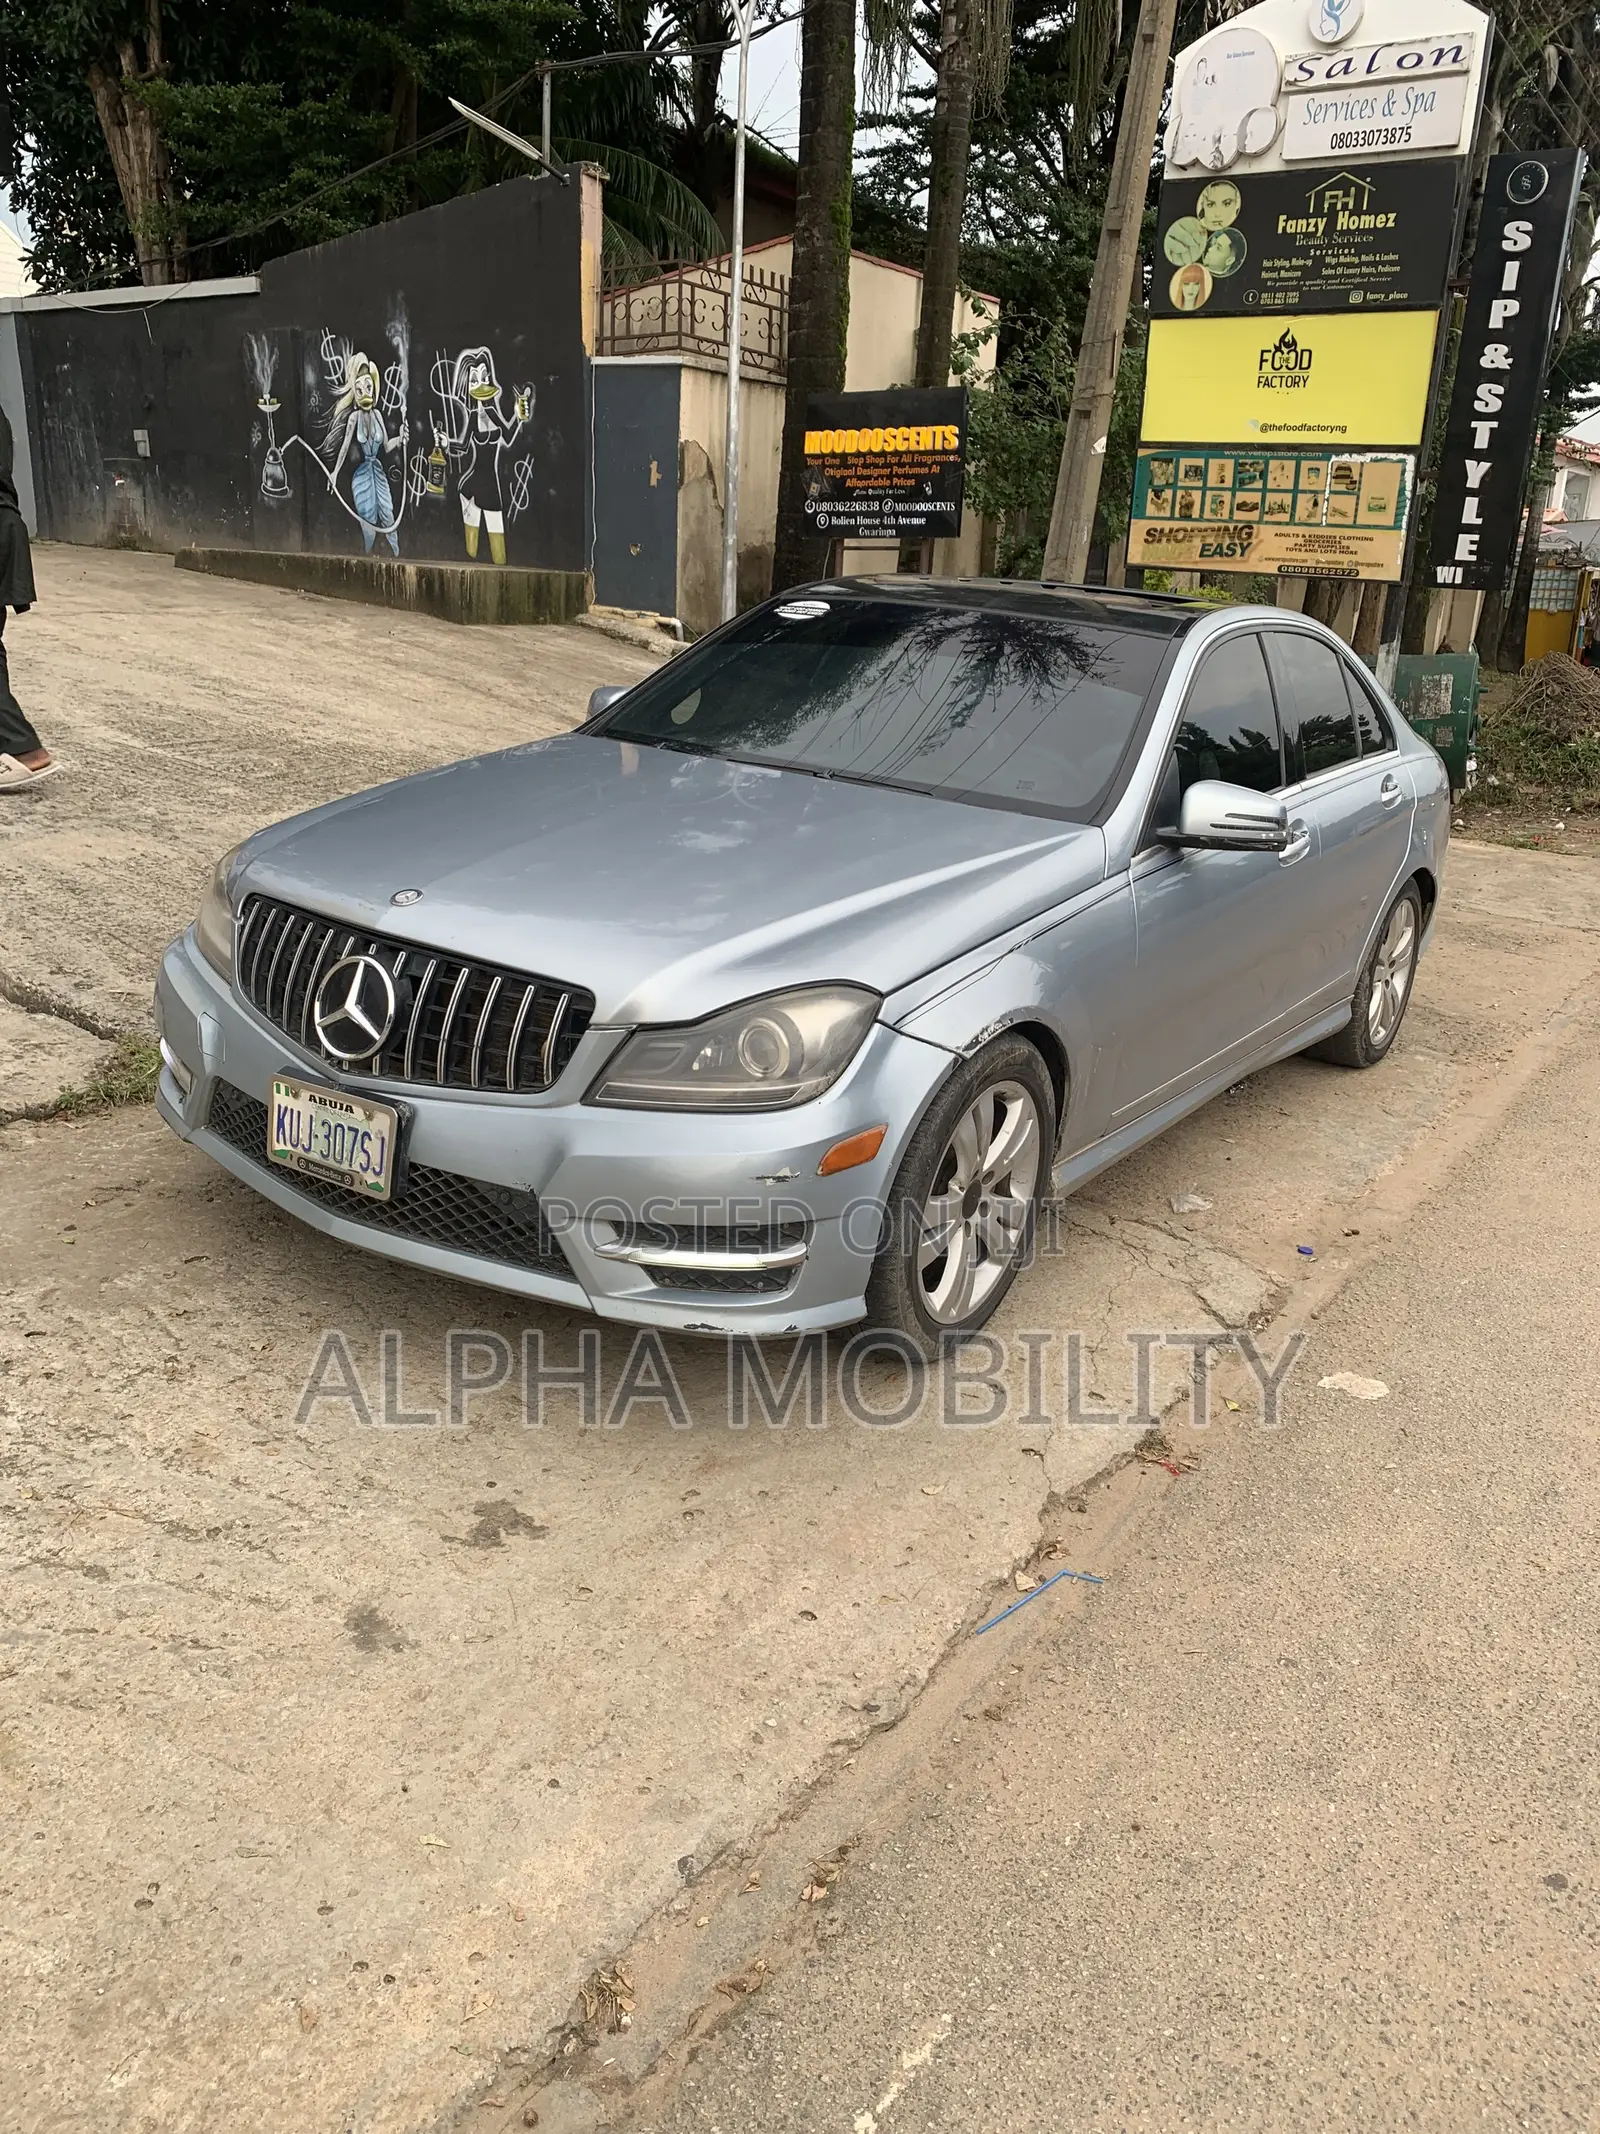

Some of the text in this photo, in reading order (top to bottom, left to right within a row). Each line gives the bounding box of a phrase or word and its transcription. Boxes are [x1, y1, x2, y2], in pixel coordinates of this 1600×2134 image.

[1303, 86, 1437, 126] Services & Spa
[1330, 126, 1412, 149] 08033073875
[1277, 210, 1397, 237] Fanzy Homez
[1295, 231, 1374, 247] Beauty Services
[1309, 247, 1355, 256] Services
[1375, 253, 1380, 261] &
[1377, 264, 1401, 273] Pedicure
[1258, 348, 1313, 371] FOOD
[1278, 356, 1292, 364] THE
[1257, 375, 1310, 388] FACTORY
[1259, 423, 1348, 434] @thefoodfactoryng
[804, 425, 960, 454] MOODOOSCENTS
[806, 453, 961, 466] Your One Stop Shop For All Fragrances,
[856, 466, 892, 476] Designer
[893, 465, 928, 474] Perfumes
[930, 464, 940, 474] At
[892, 477, 916, 486] Prices
[816, 500, 956, 512] 08036226838 MOODOOSCENTS
[856, 515, 881, 525] House
[882, 515, 896, 525] 4th
[897, 514, 927, 525] Avenue
[1199, 542, 1253, 558] EASY
[308, 1094, 355, 1115] ABUJA
